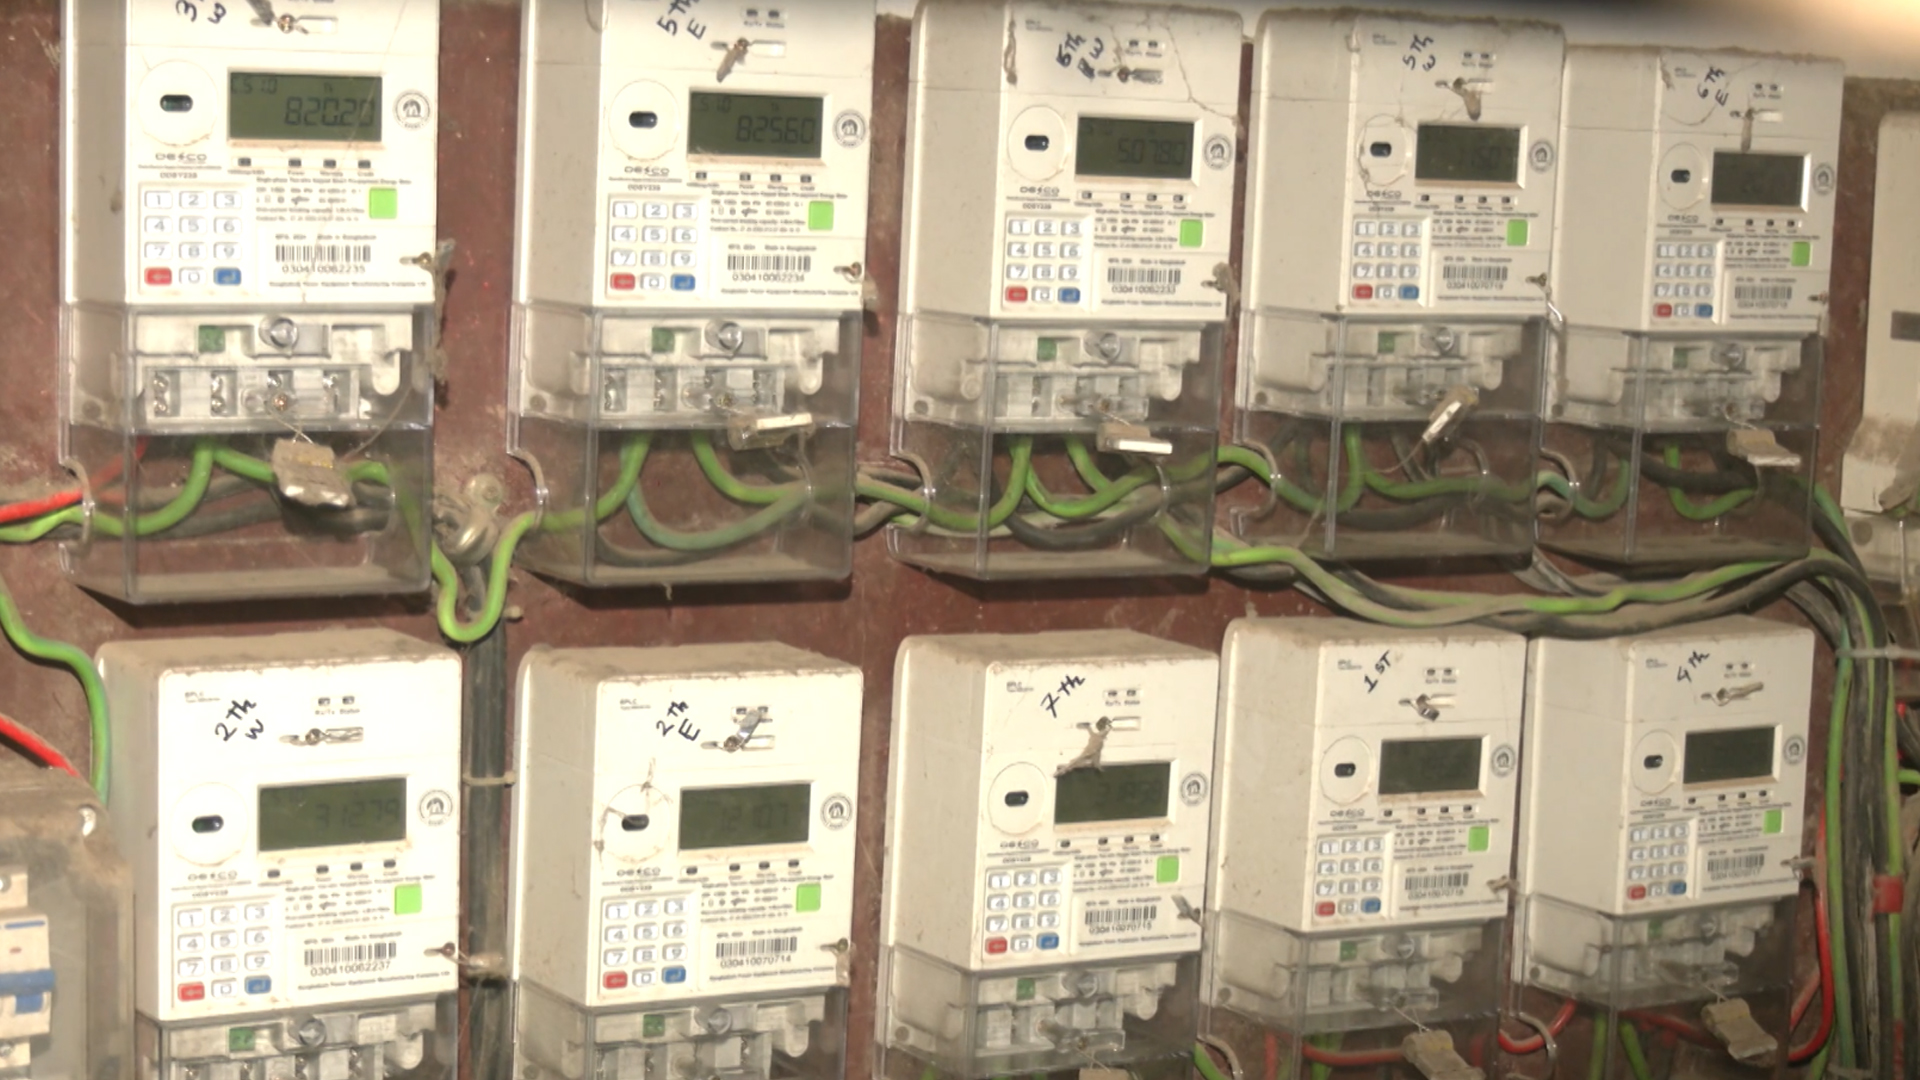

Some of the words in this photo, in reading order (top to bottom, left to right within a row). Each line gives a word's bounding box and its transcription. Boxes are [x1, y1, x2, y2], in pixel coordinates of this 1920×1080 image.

[686, 17, 707, 40] E
[1714, 88, 1729, 107] E
[188, 194, 200, 206] 2
[224, 194, 235, 206] 3
[651, 205, 661, 217] 2
[682, 206, 692, 217] 3
[153, 220, 165, 232] 4
[188, 220, 200, 232] 5
[223, 220, 235, 232] 6
[1043, 222, 1052, 233] 2
[1071, 223, 1080, 233] 3
[620, 229, 630, 240] 4
[650, 229, 661, 241] 5
[681, 230, 691, 241] 6
[154, 245, 166, 257] 7
[189, 245, 200, 257] 8
[223, 245, 235, 257] 9
[1016, 245, 1025, 255] 4
[1042, 245, 1051, 256] 5
[1069, 246, 1078, 256] 6
[620, 252, 630, 263] 7
[650, 253, 660, 264] 8
[680, 253, 690, 265] 9
[1015, 266, 1024, 277] 7
[1041, 267, 1050, 278] 8
[1068, 268, 1077, 279] 9
[677, 717, 701, 742] E
[644, 904, 654, 915] 2
[674, 901, 684, 912] 3
[221, 911, 232, 923] 2
[254, 908, 265, 919] 3
[613, 930, 624, 941] 4
[643, 927, 653, 938] 5
[673, 924, 683, 935] 6
[187, 939, 198, 951] 4
[221, 935, 232, 947] 5
[254, 932, 265, 944] 6
[613, 952, 623, 963] 7
[643, 950, 653, 961] 8
[672, 947, 682, 958] 9
[187, 963, 198, 975] 7
[221, 959, 232, 971] 8
[254, 956, 265, 968] 9
[310, 961, 391, 977] 030410062237
